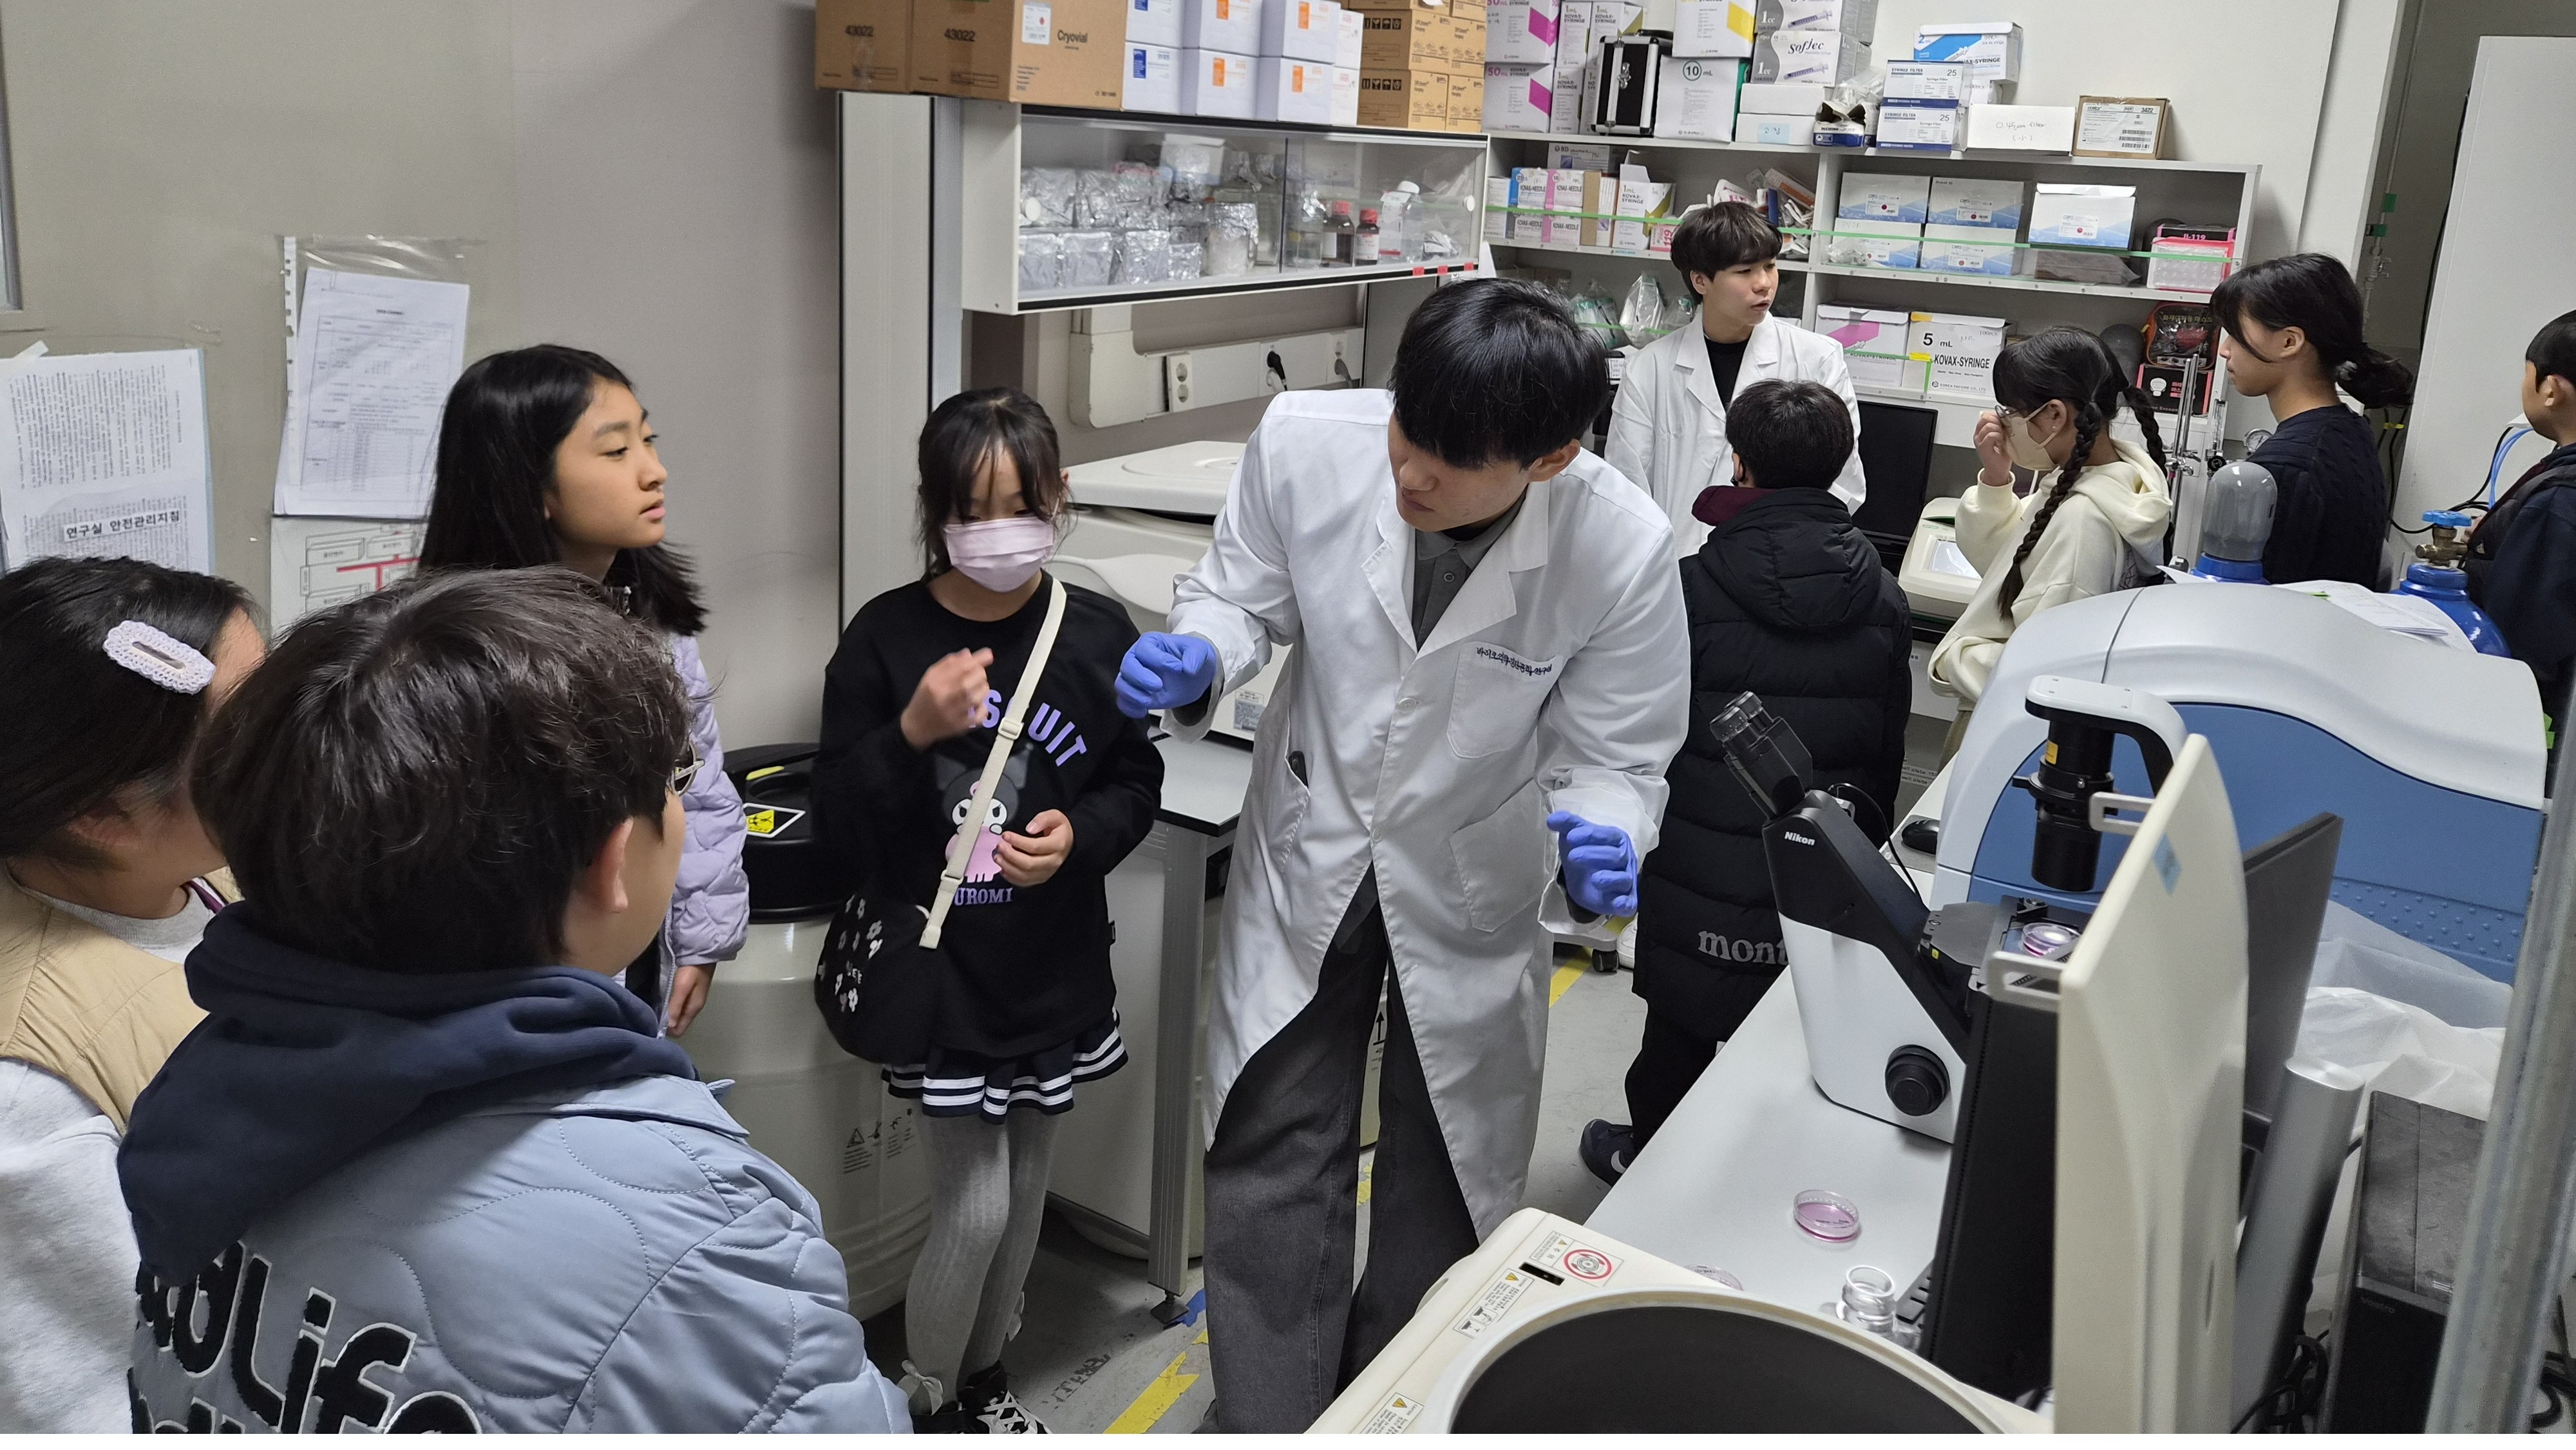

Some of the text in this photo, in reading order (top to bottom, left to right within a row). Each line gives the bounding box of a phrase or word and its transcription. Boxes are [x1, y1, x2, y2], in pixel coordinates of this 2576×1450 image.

[944, 28, 976, 42] 43022
[1057, 29, 1088, 44] Cryovial
[1922, 332, 1933, 346] 5
[1934, 353, 1990, 369] KOVAX-SYRINGE
[66, 522, 103, 539] 연구실
[1784, 831, 1815, 846] Nikon
[954, 887, 1014, 907] UROMI
